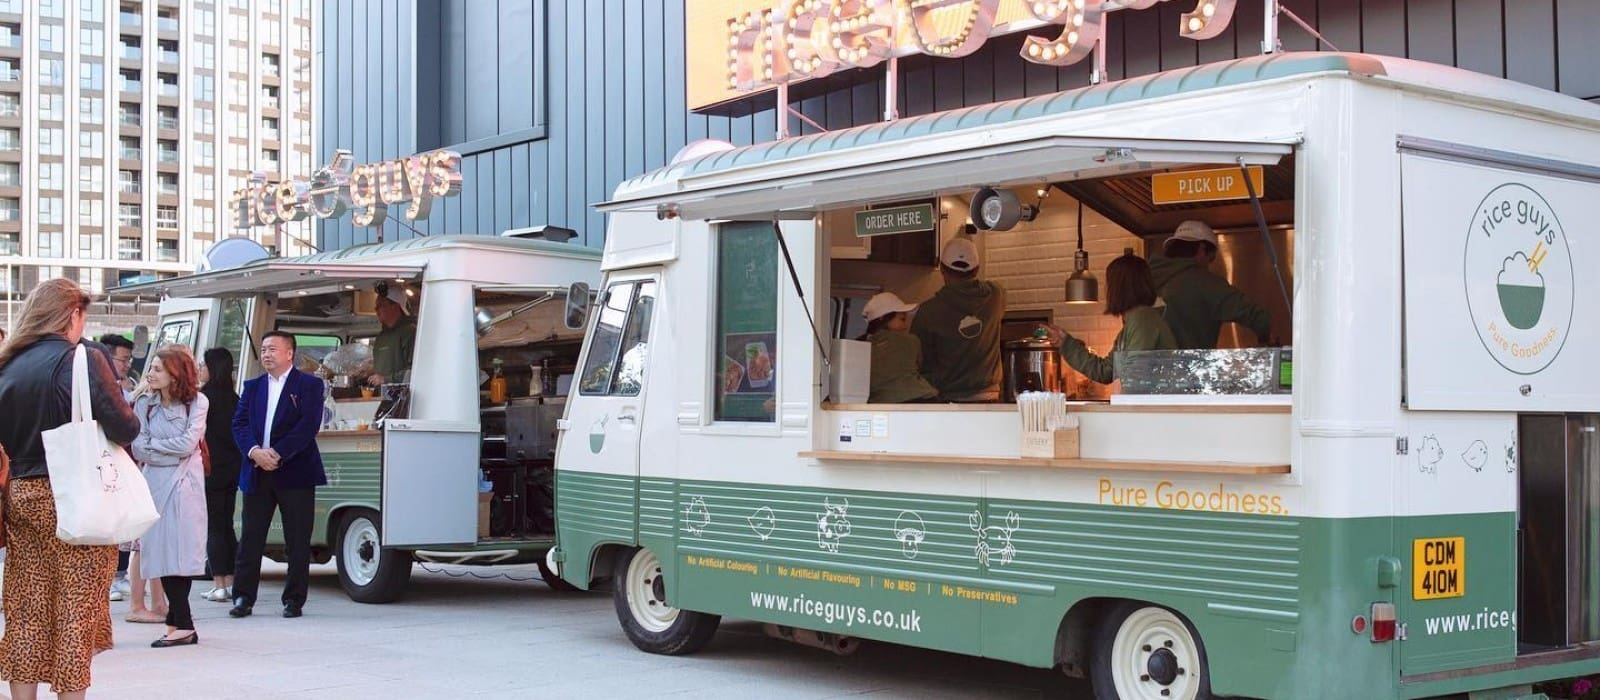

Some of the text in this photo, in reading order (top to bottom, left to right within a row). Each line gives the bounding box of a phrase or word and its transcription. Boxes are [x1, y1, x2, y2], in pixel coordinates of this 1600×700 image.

[232, 151, 462, 228] rice guys
[1179, 176, 1234, 194] PICK UP
[865, 211, 921, 229] ORDER HERE
[1481, 200, 1556, 245] rice guys
[1487, 322, 1509, 350] Pure
[1098, 477, 1289, 516] Pure Goodness.
[1424, 541, 1456, 566] CDM
[687, 555, 1018, 605] No Artificial Colouring No Artificial Flavouring No MSG No Preservatives
[1422, 569, 1458, 594] 410M
[750, 591, 921, 633] www.riceguys.co.uk
